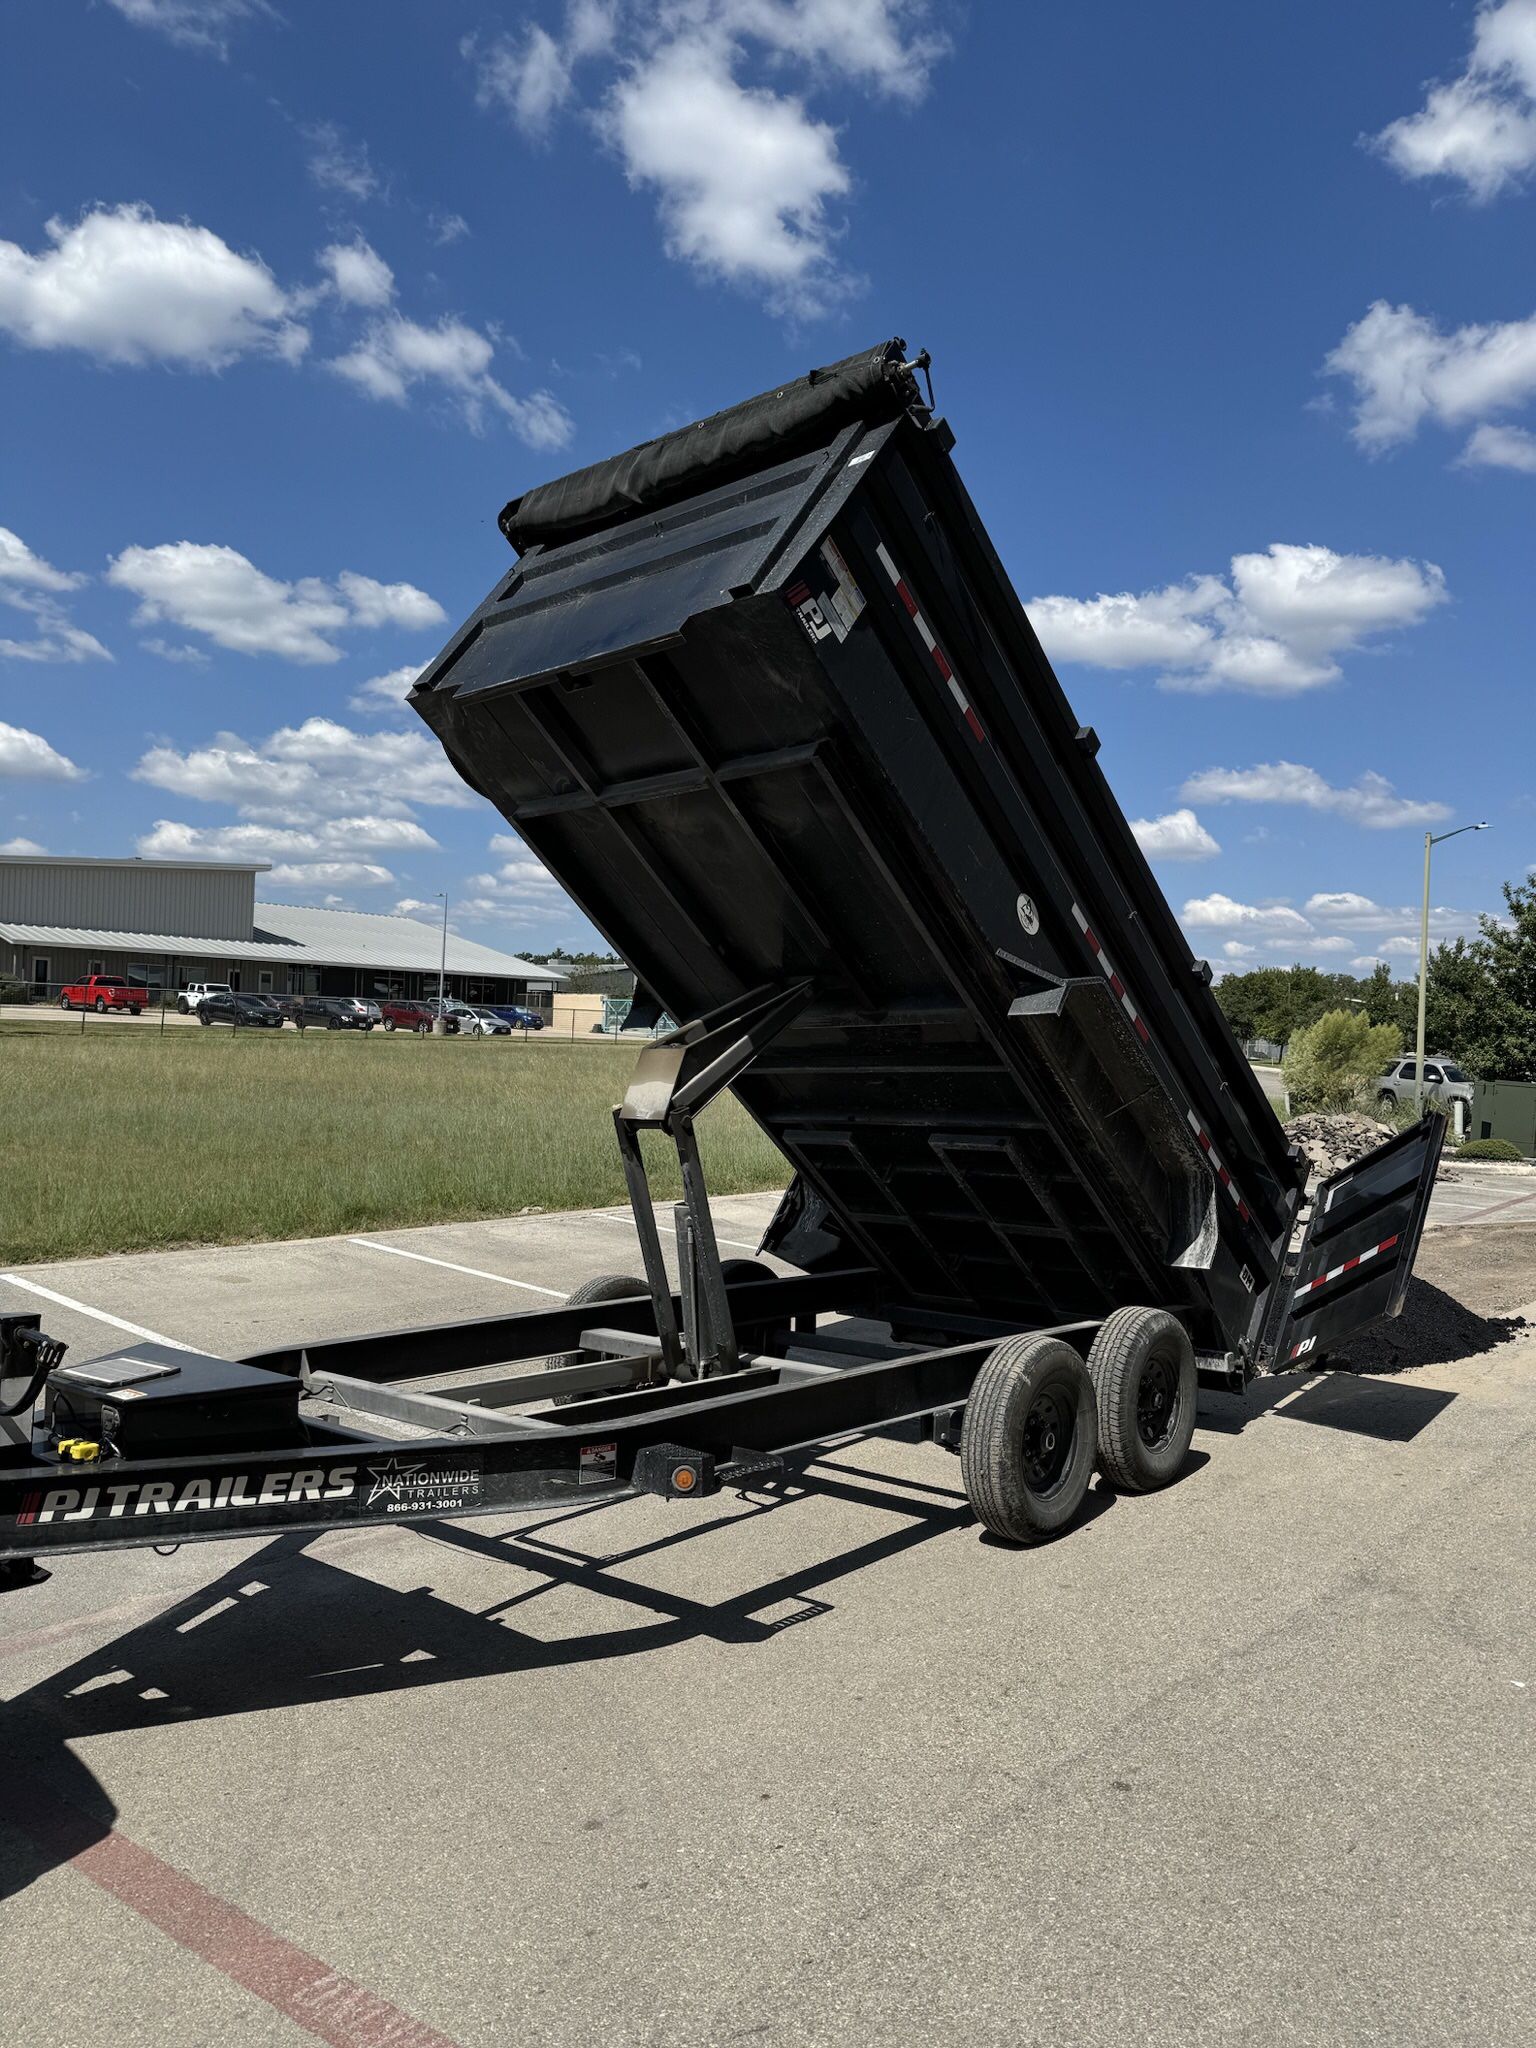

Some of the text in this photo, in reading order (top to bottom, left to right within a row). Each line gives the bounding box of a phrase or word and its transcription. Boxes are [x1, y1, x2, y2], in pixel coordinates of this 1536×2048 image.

[796, 606, 819, 644] TRAILERS
[800, 597, 832, 640] PJ
[1296, 1335, 1318, 1357] PJ
[382, 1469, 480, 1487] NATIONWIDE
[38, 1467, 358, 1522] PJ TRAILERS
[408, 1485, 479, 1498] TRAILERS
[386, 1499, 463, 1512] 866-931-3001
